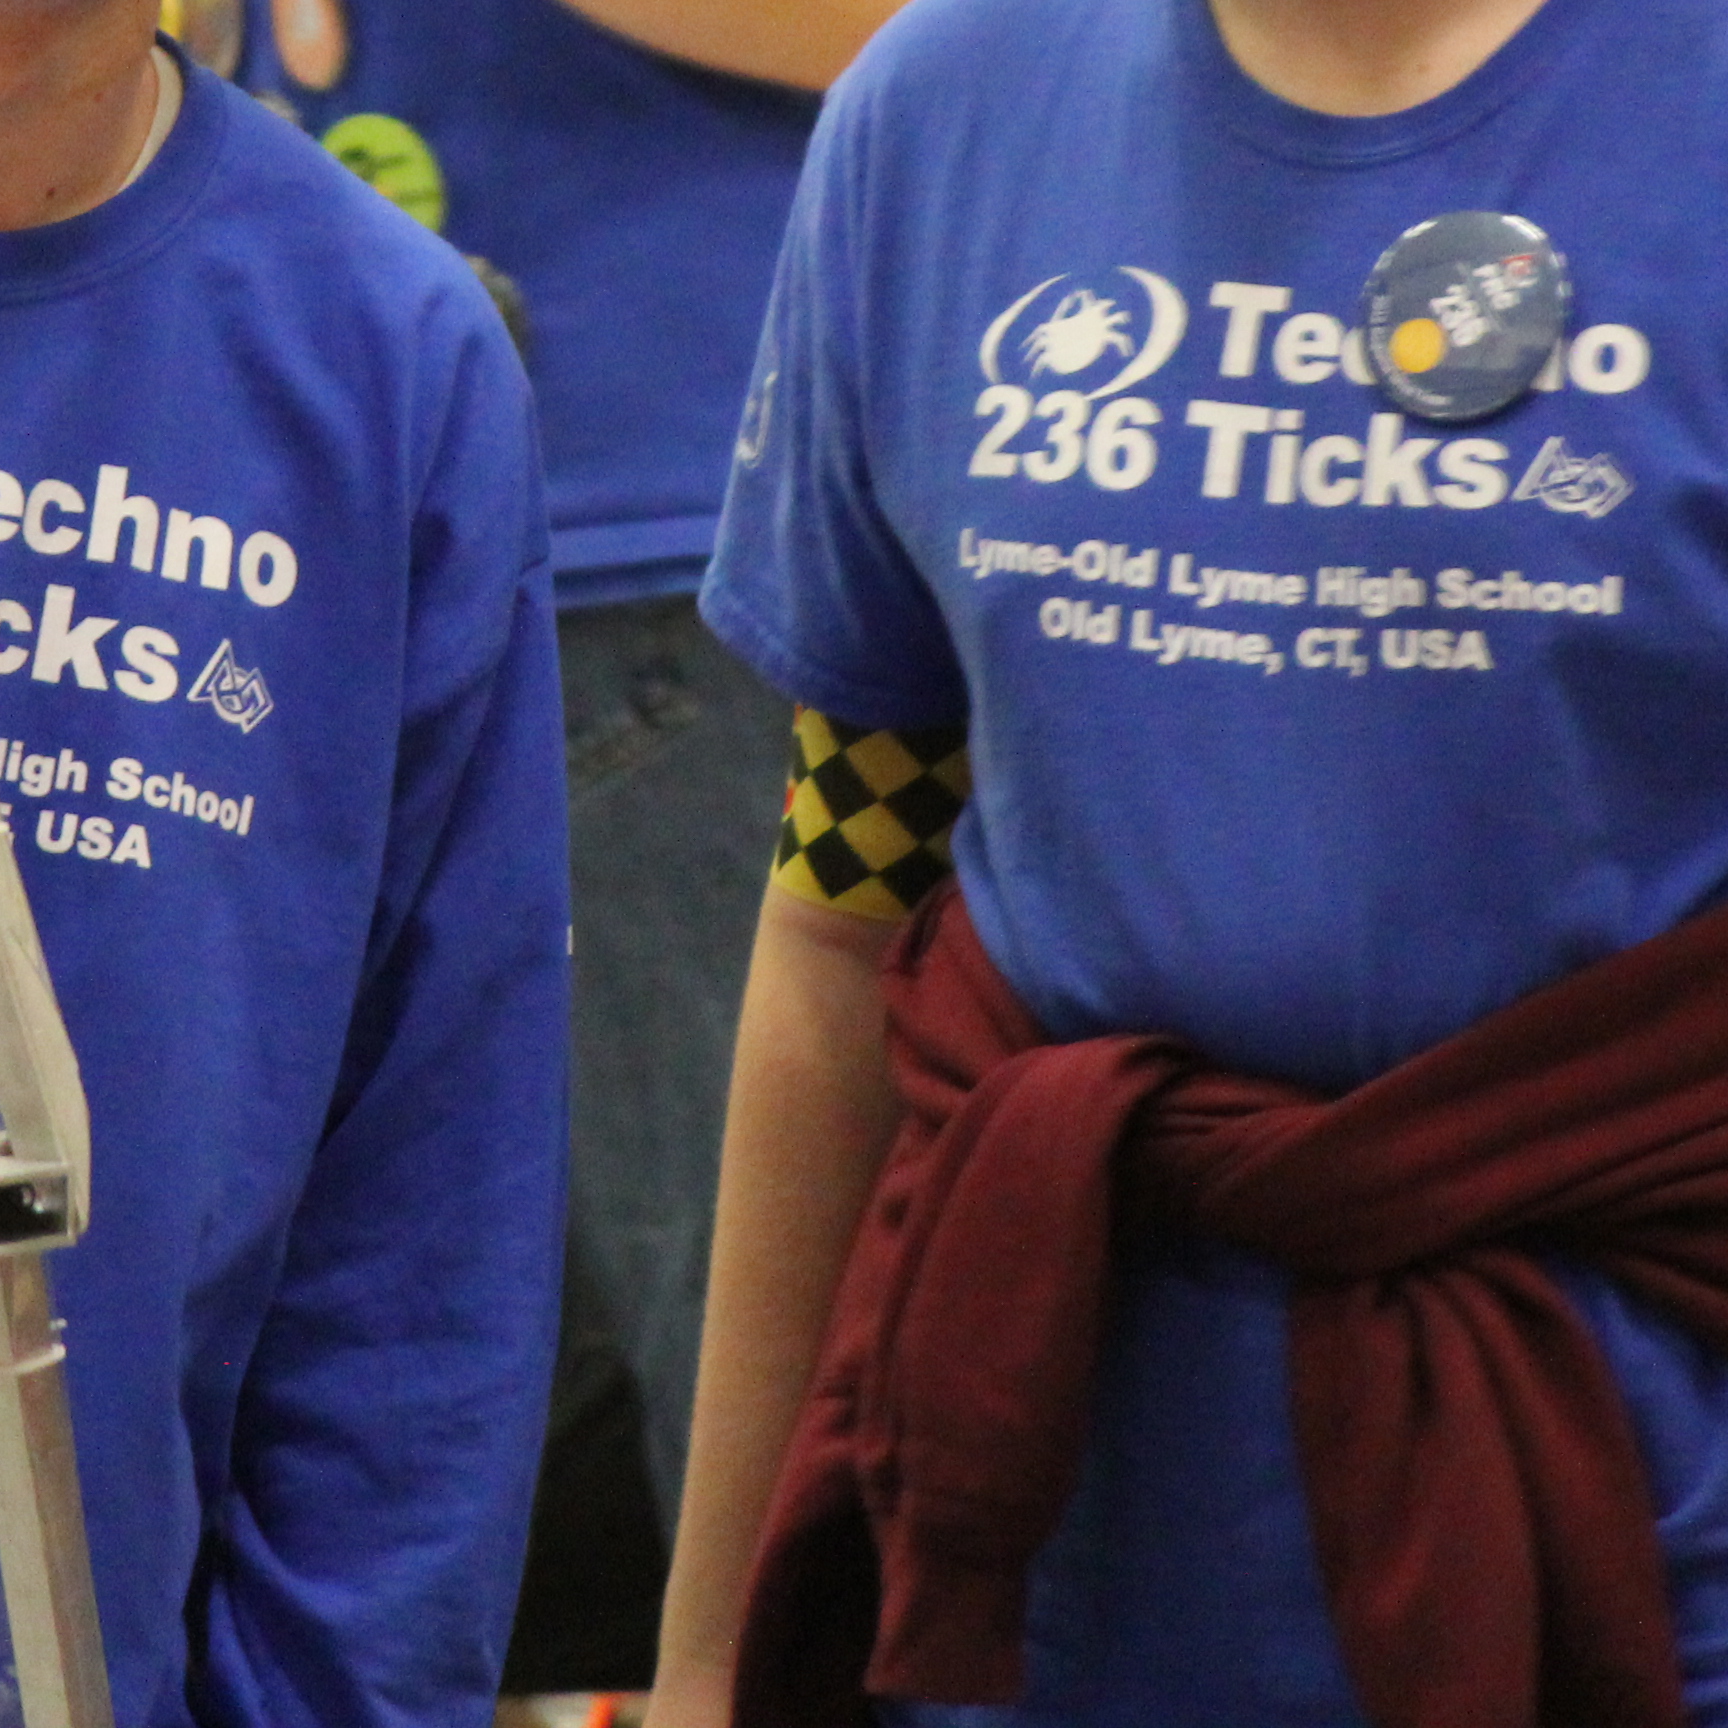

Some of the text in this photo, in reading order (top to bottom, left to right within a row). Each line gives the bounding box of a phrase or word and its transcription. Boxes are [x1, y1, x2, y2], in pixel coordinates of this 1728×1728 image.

[1210, 282, 1650, 394] Teo
[969, 384, 1510, 511] 236 Ticks
[960, 527, 1624, 618] Lyme-Old Lyme High School
[1038, 596, 1496, 678] Old Lyme, CT, USA
[105, 756, 255, 836] School
[35, 809, 153, 870] USA
